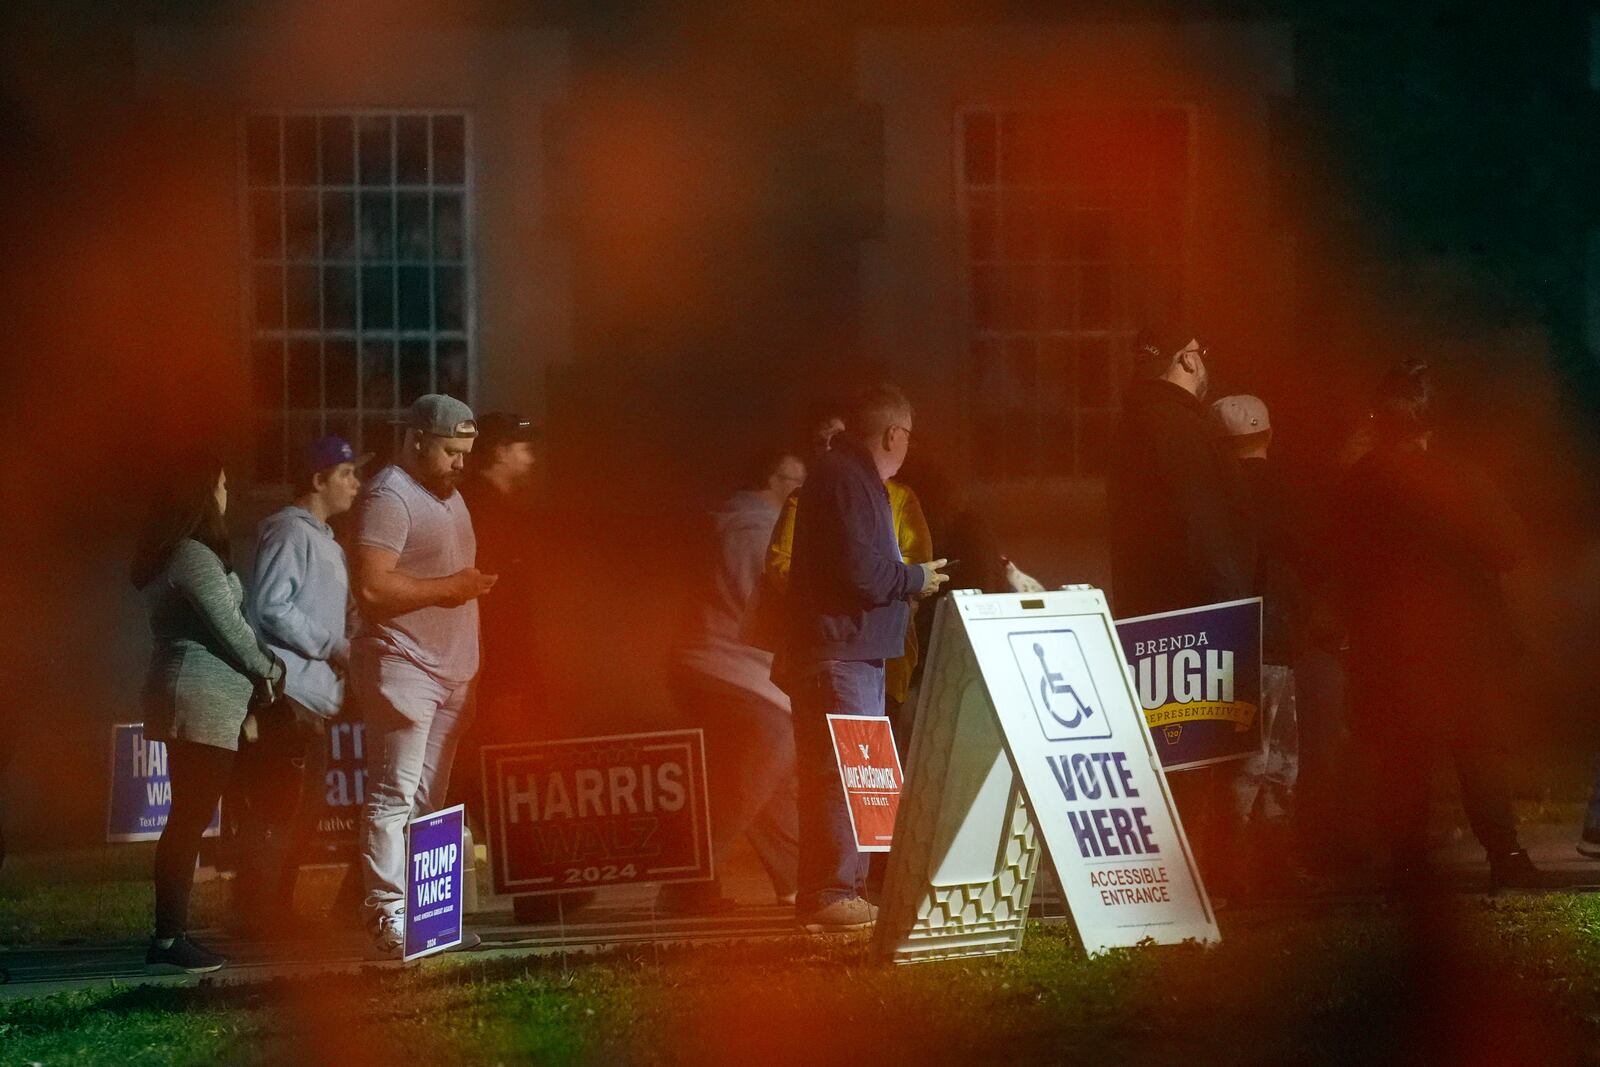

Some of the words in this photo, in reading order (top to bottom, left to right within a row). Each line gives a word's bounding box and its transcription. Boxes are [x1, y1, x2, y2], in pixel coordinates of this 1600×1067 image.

[1135, 631, 1209, 656] BRENDA
[1145, 705, 1241, 724] EPRESENTATIVE
[1045, 751, 1140, 801] VOTE
[506, 761, 686, 824] HARRIS
[139, 816, 156, 828] Text
[1066, 807, 1161, 858] HERE
[534, 816, 662, 866] WALZ
[413, 843, 457, 882] TRUMP
[563, 863, 638, 884] 2024
[1090, 867, 1170, 888] ACCESSIBLE
[417, 876, 452, 908] VANCE
[1100, 886, 1171, 906] ENTRANCE
